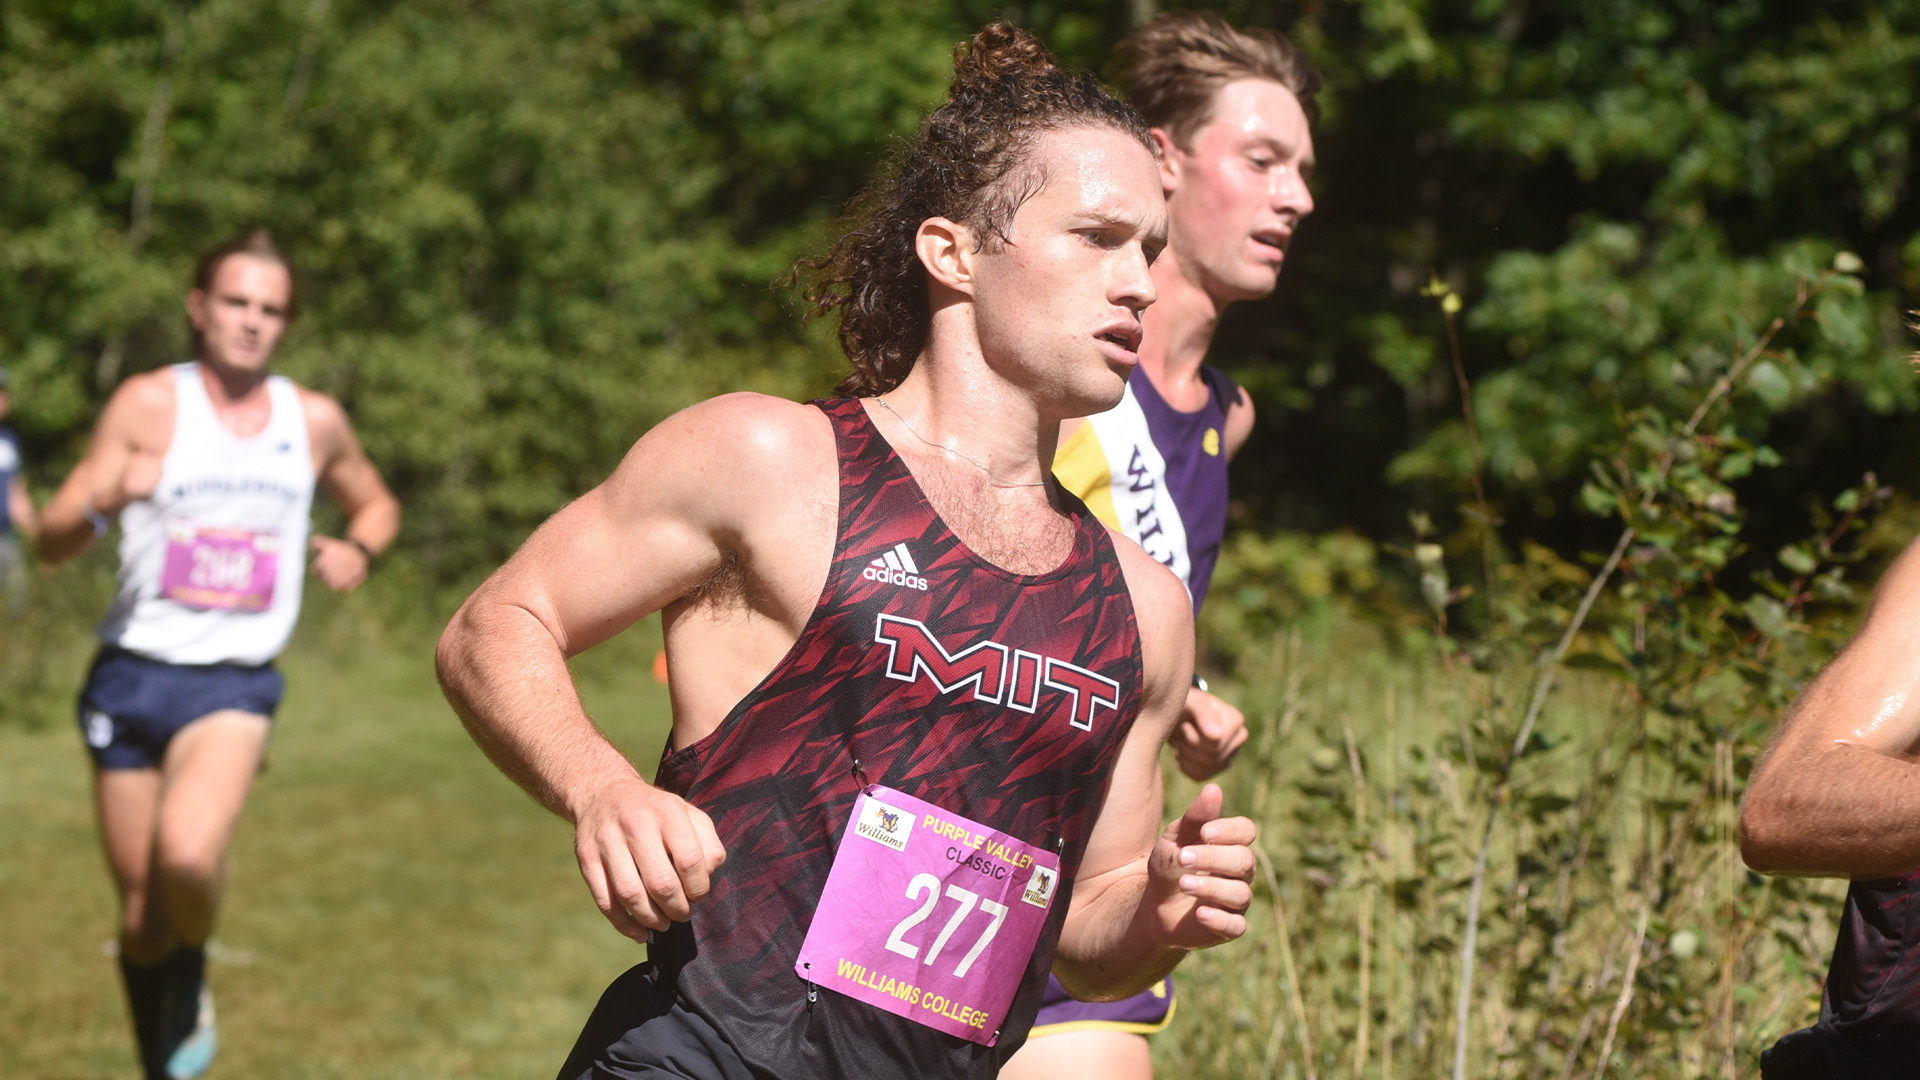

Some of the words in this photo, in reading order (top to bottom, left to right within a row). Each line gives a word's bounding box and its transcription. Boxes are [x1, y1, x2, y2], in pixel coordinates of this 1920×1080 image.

[863, 566, 928, 591] adidas
[874, 613, 1120, 732] MIT
[858, 822, 904, 848] Williams
[922, 814, 985, 850] PURPLE
[986, 838, 1034, 870] VALLEY
[945, 846, 1006, 880] CLASSIC
[884, 872, 1009, 978] 277
[837, 958, 920, 1005] WILLIAMS
[921, 991, 989, 1029] COLLEGE
